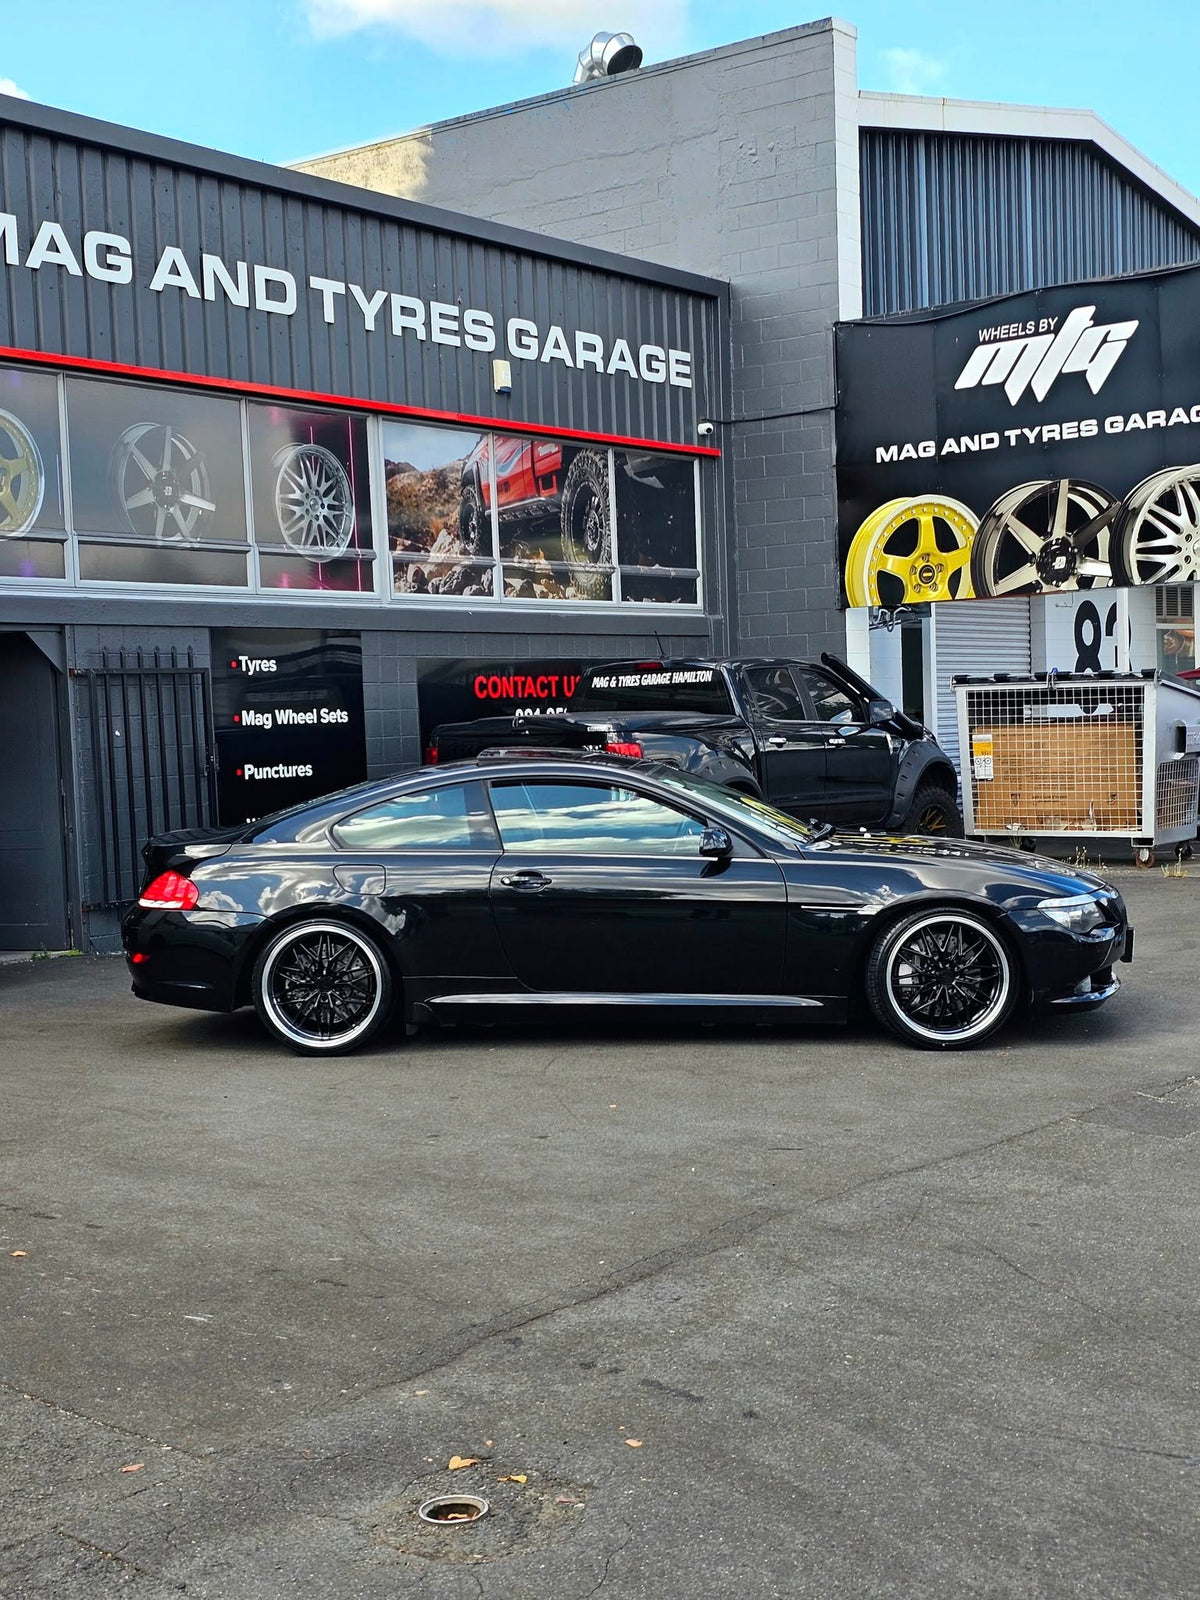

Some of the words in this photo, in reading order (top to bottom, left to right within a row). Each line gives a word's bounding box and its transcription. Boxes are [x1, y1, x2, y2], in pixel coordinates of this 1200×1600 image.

[150, 246, 297, 316] AND
[309, 275, 496, 353] TYRES
[507, 317, 693, 389] GARAGE
[978, 320, 1036, 343] WHEELS
[1038, 316, 1059, 331] BY
[875, 440, 936, 464] MAG
[940, 432, 999, 456] AND
[1003, 419, 1099, 446] TYRES
[239, 655, 277, 676] Tyres
[474, 675, 559, 698] CONTACT
[563, 675, 581, 697] U
[591, 676, 611, 688] MAG
[610, 677, 617, 688] &
[618, 674, 641, 687] TYRES
[641, 672, 672, 686] GARAGE
[671, 670, 713, 684] HAMILTON
[242, 710, 272, 729] Mag
[275, 708, 318, 725] Wheel
[320, 708, 349, 723] Sets
[244, 763, 313, 780] Punctures
